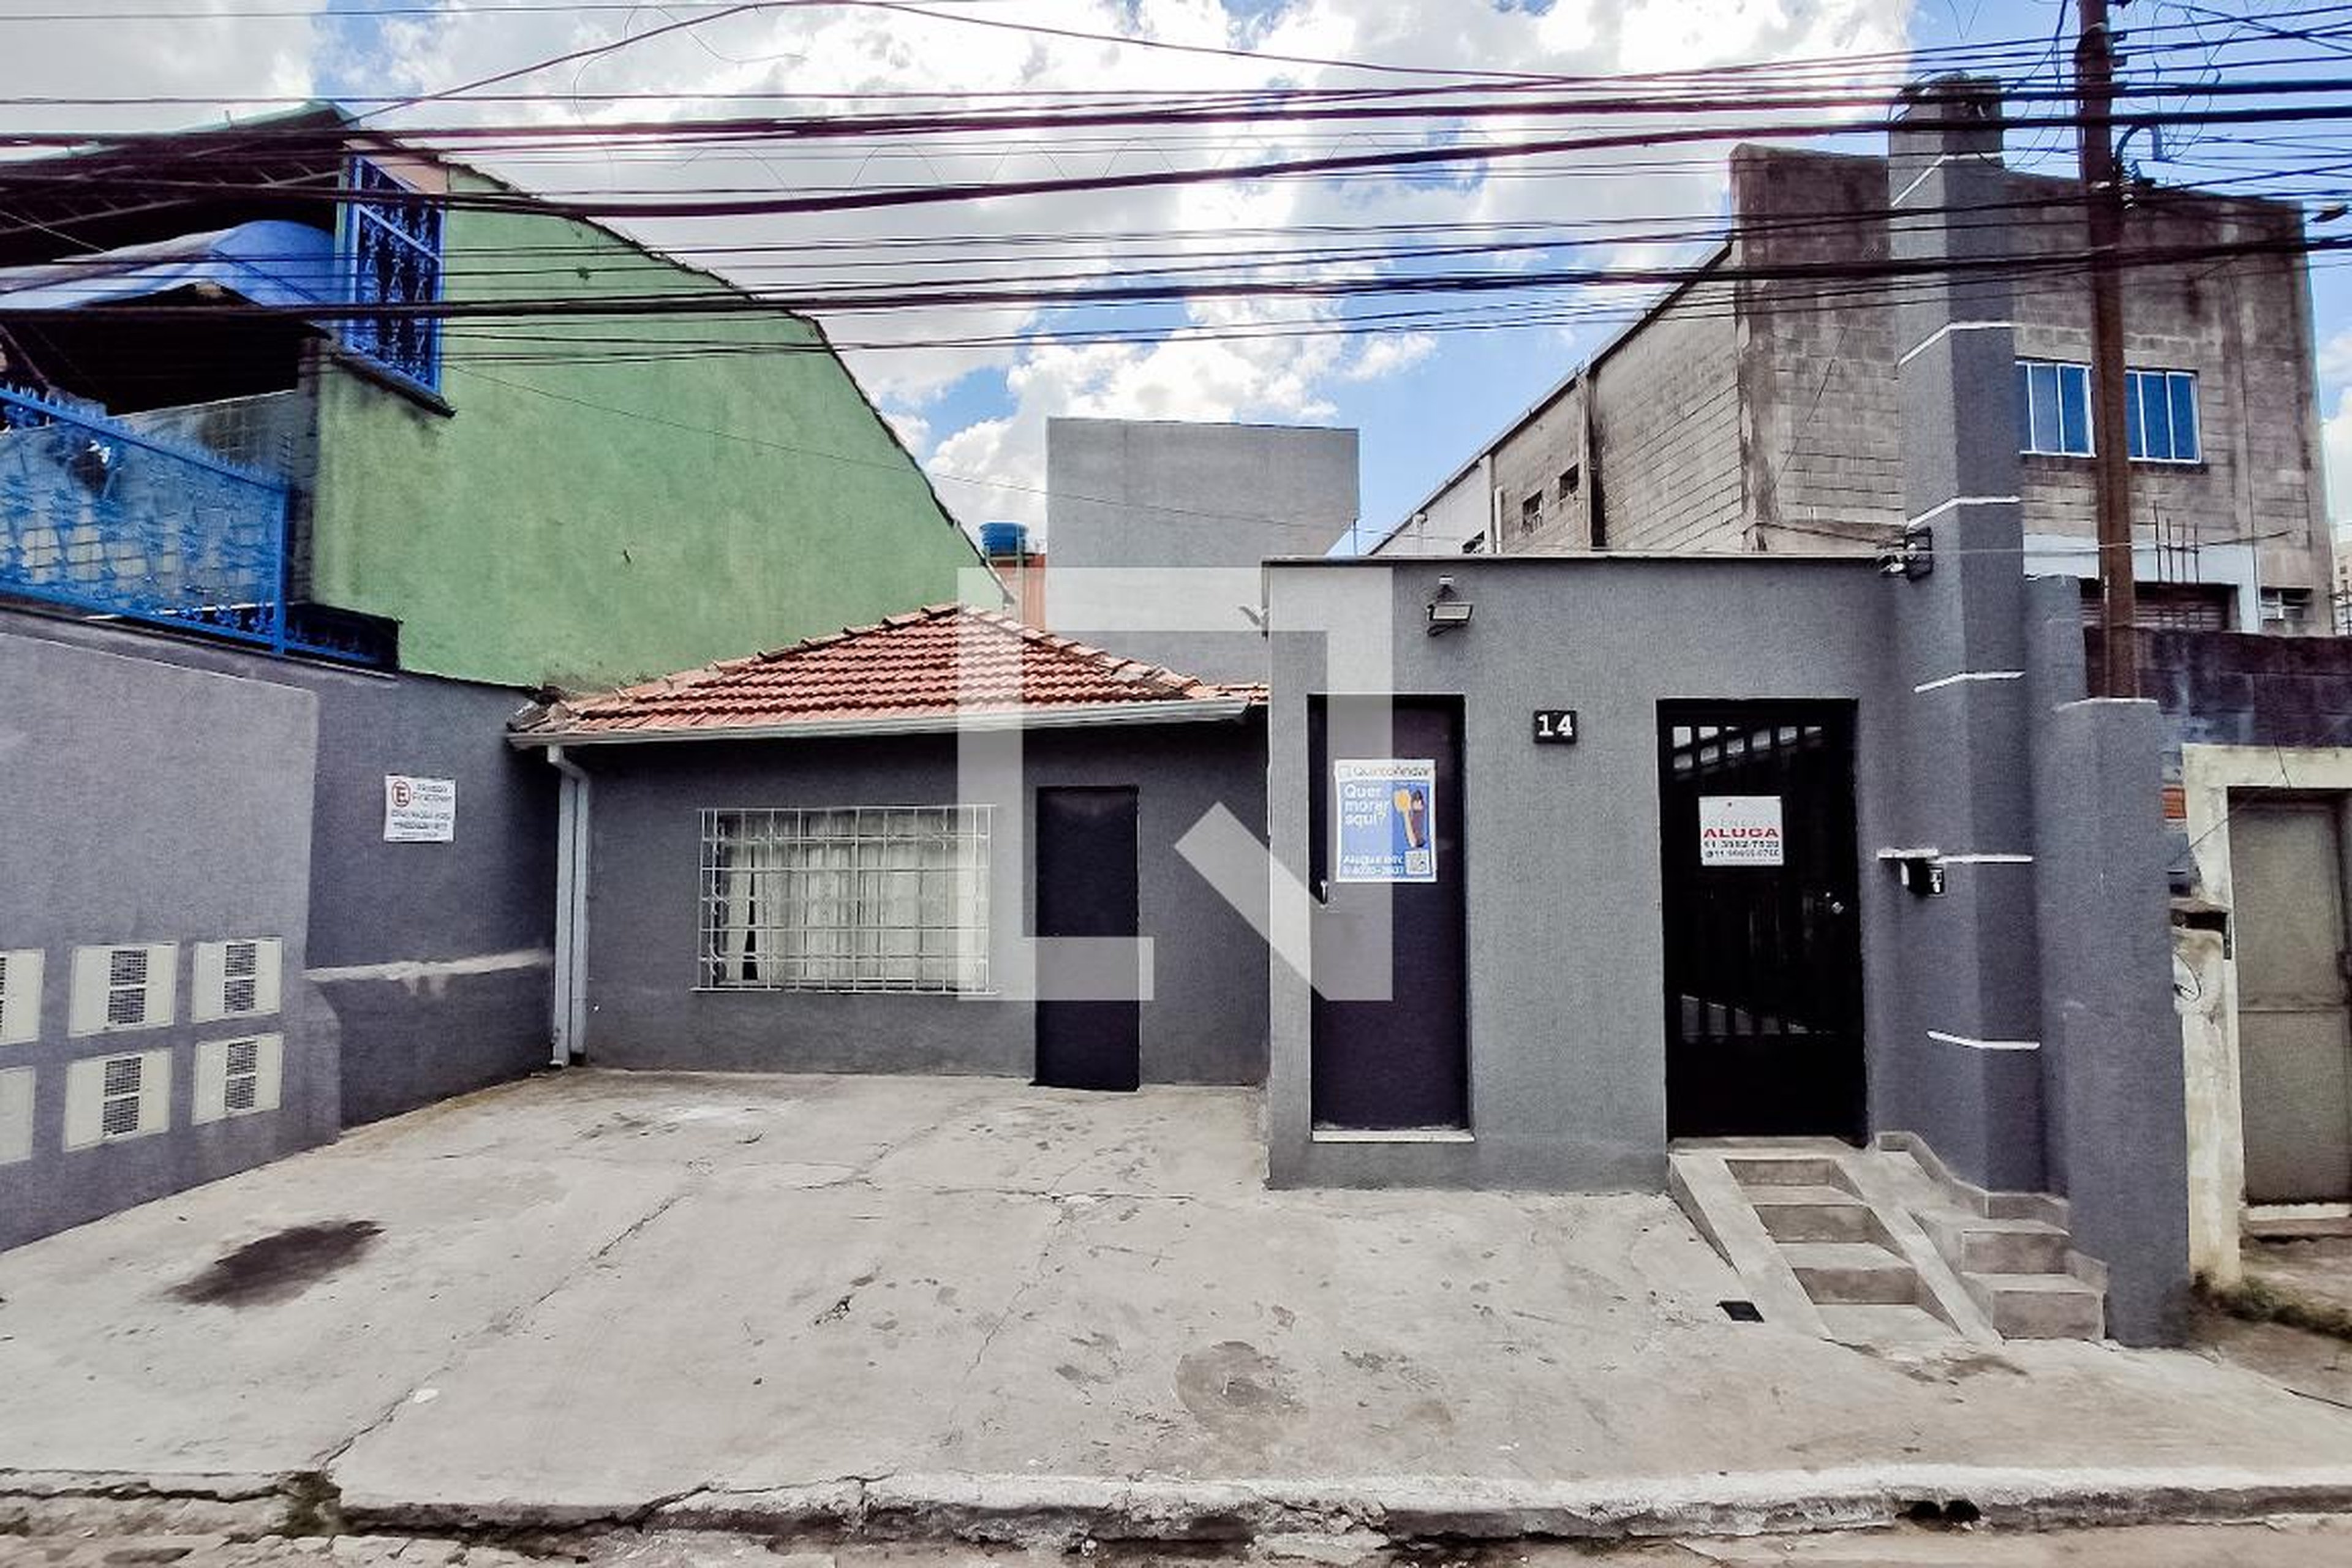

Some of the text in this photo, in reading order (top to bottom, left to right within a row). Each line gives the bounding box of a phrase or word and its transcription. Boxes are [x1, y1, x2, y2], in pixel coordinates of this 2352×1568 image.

[1538, 714, 1573, 736] 14
[1344, 783, 1382, 798] Quer
[1344, 799, 1391, 813] morar
[1344, 812, 1387, 828] aqui?
[1704, 828, 1779, 838] ALUGA
